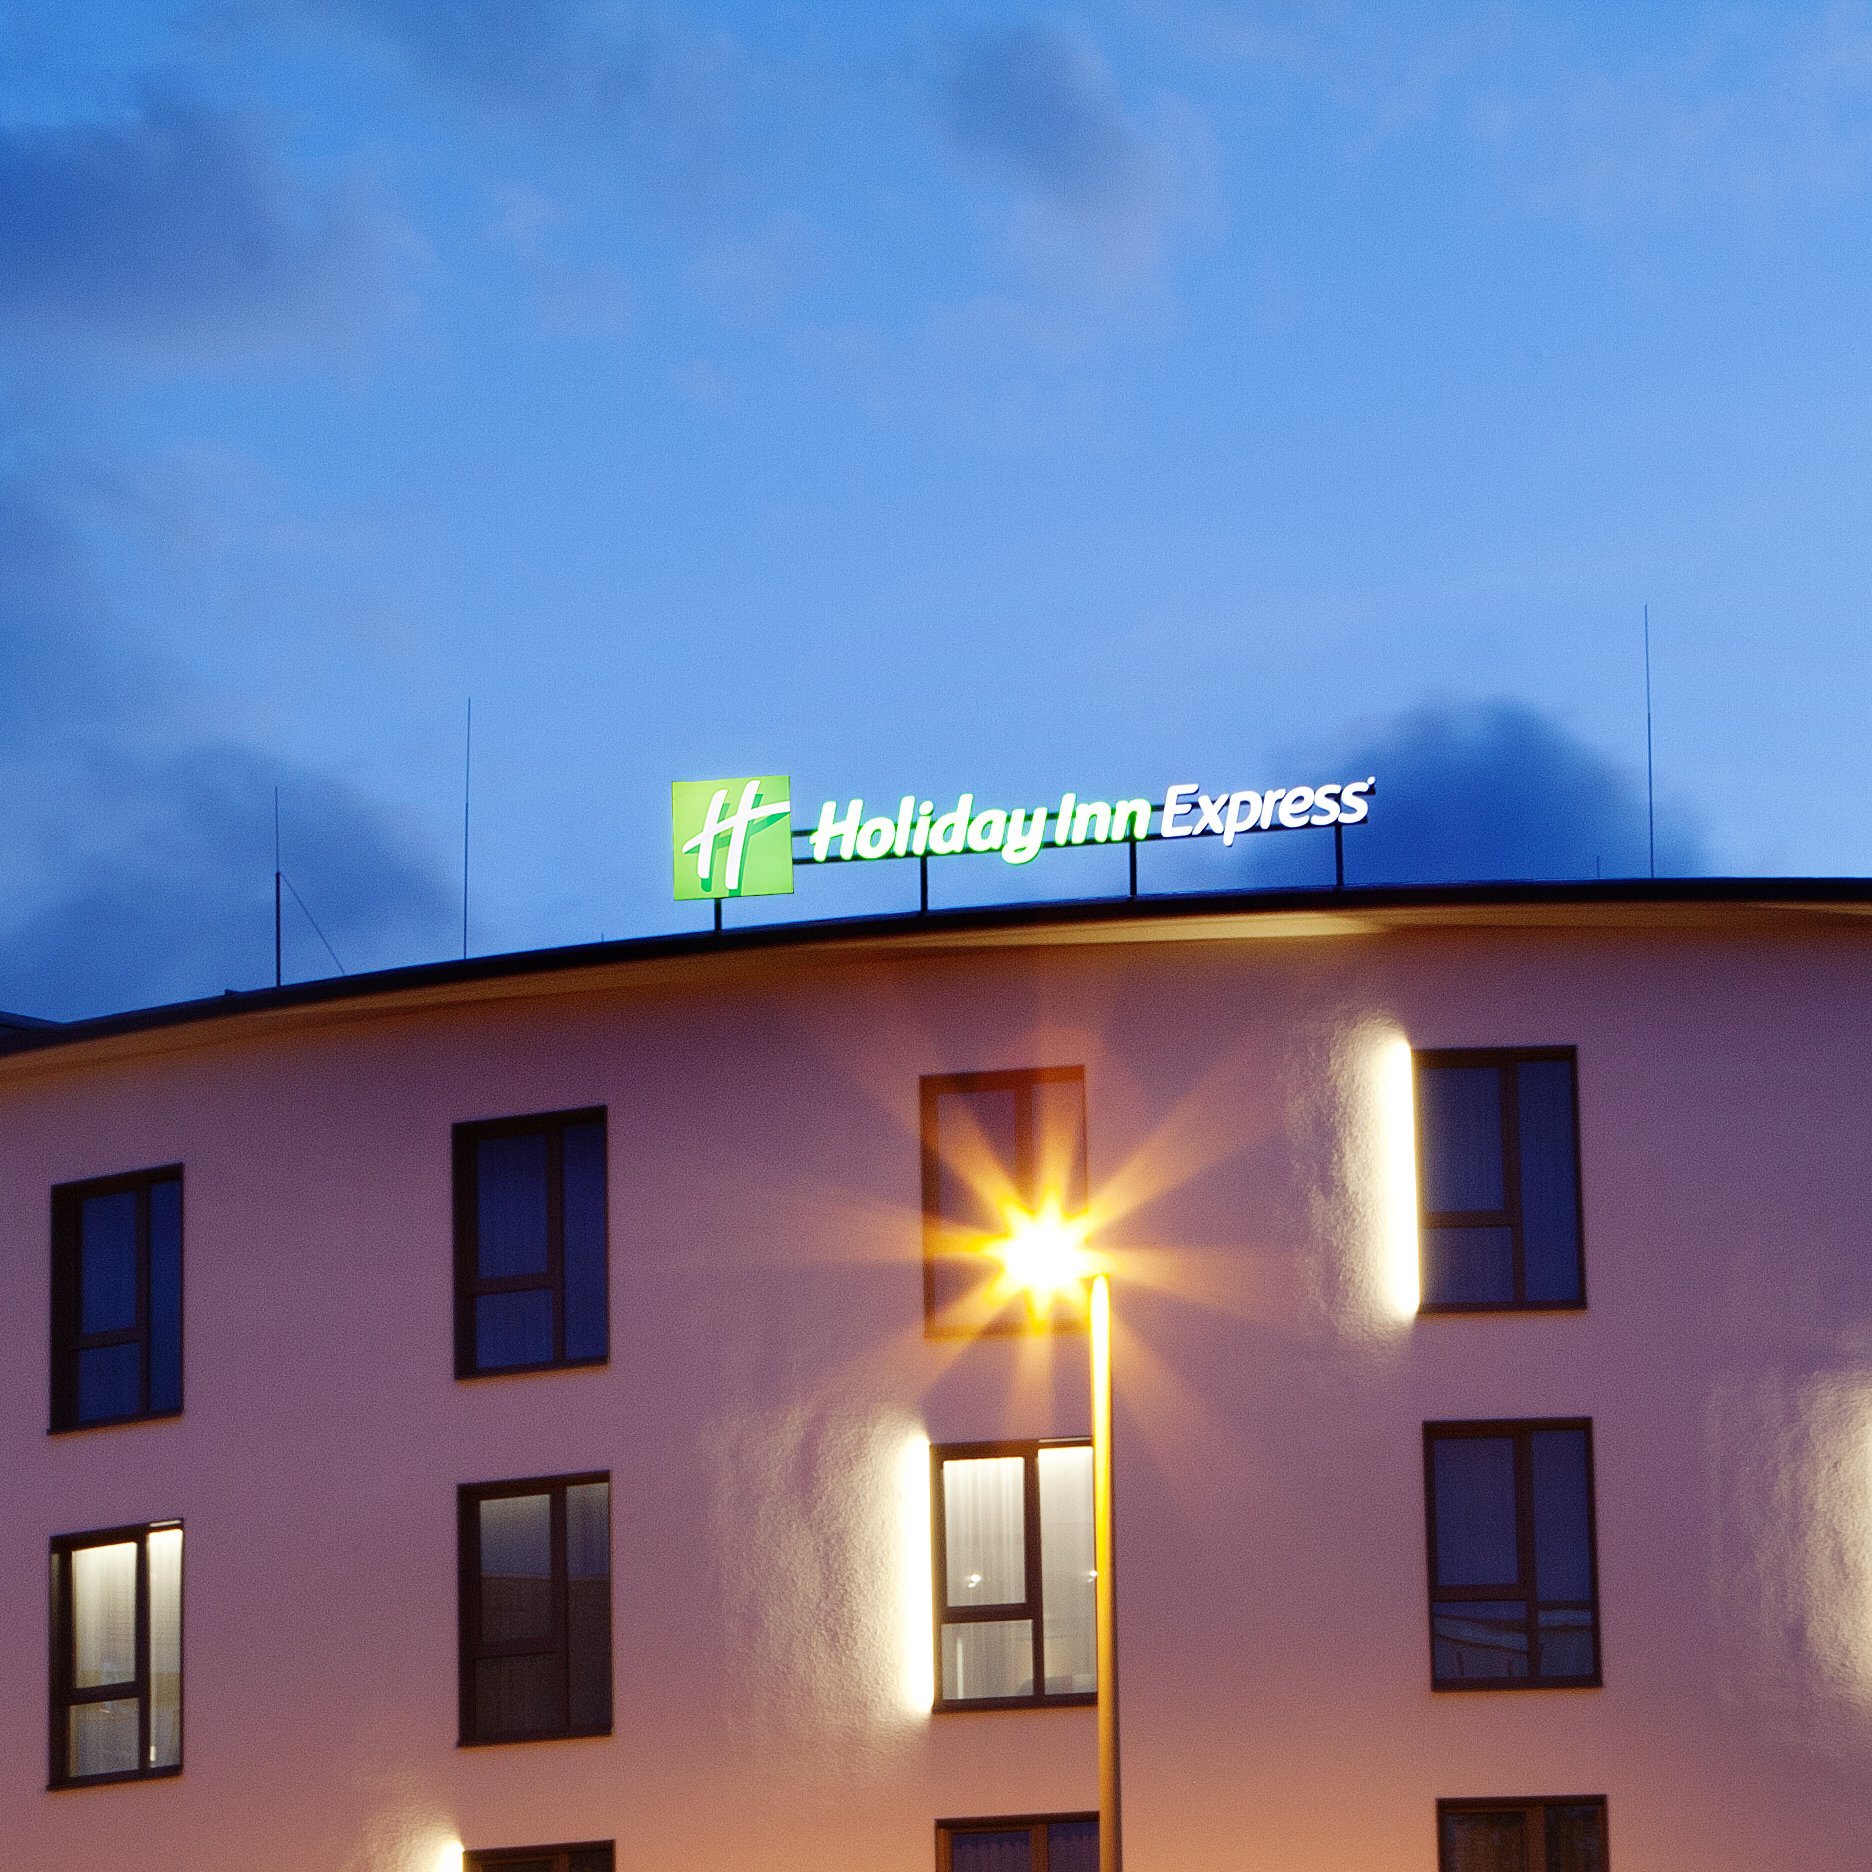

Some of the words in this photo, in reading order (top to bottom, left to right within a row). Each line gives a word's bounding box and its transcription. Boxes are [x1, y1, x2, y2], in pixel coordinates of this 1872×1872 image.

[809, 793, 1048, 865] Holiday
[1054, 792, 1151, 846] Inn
[1160, 777, 1375, 847] Express
